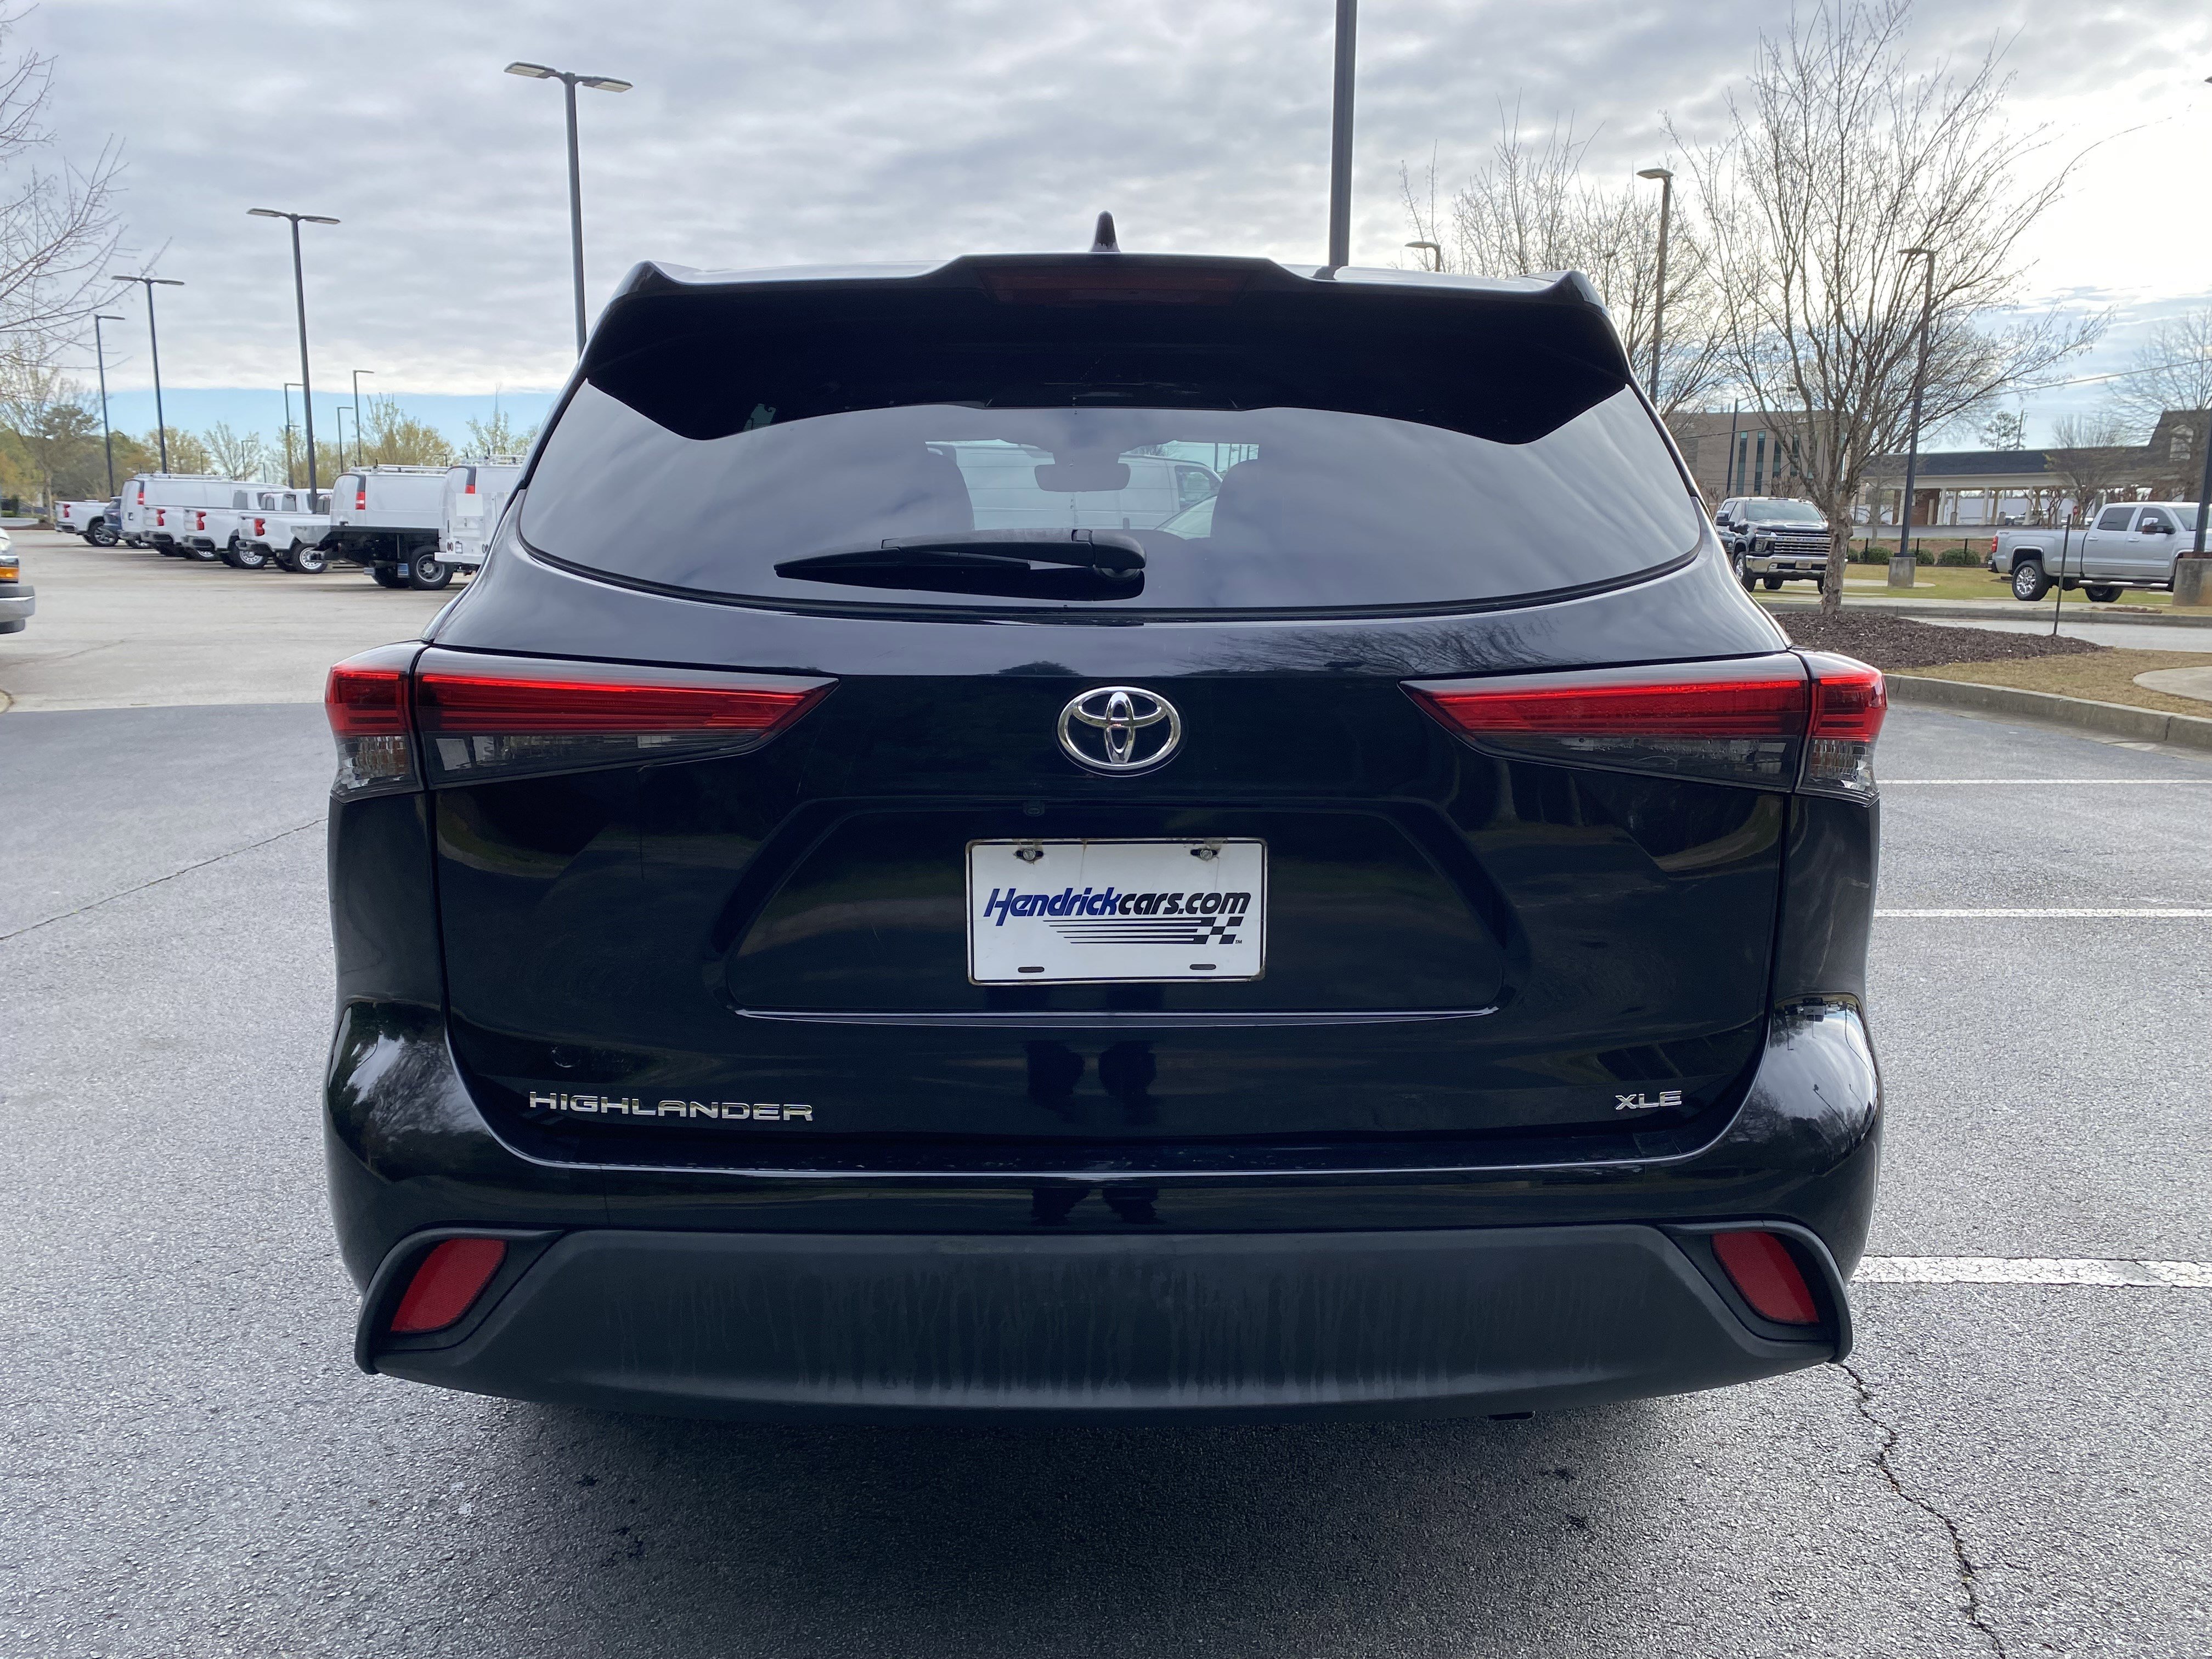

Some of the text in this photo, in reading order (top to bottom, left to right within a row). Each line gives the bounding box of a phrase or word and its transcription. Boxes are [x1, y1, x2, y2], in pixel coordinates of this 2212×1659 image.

[984, 887, 1251, 926] Hendrickcars.com
[529, 1091, 813, 1121] HIGHLANDER
[1615, 1090, 1682, 1110] XLE
